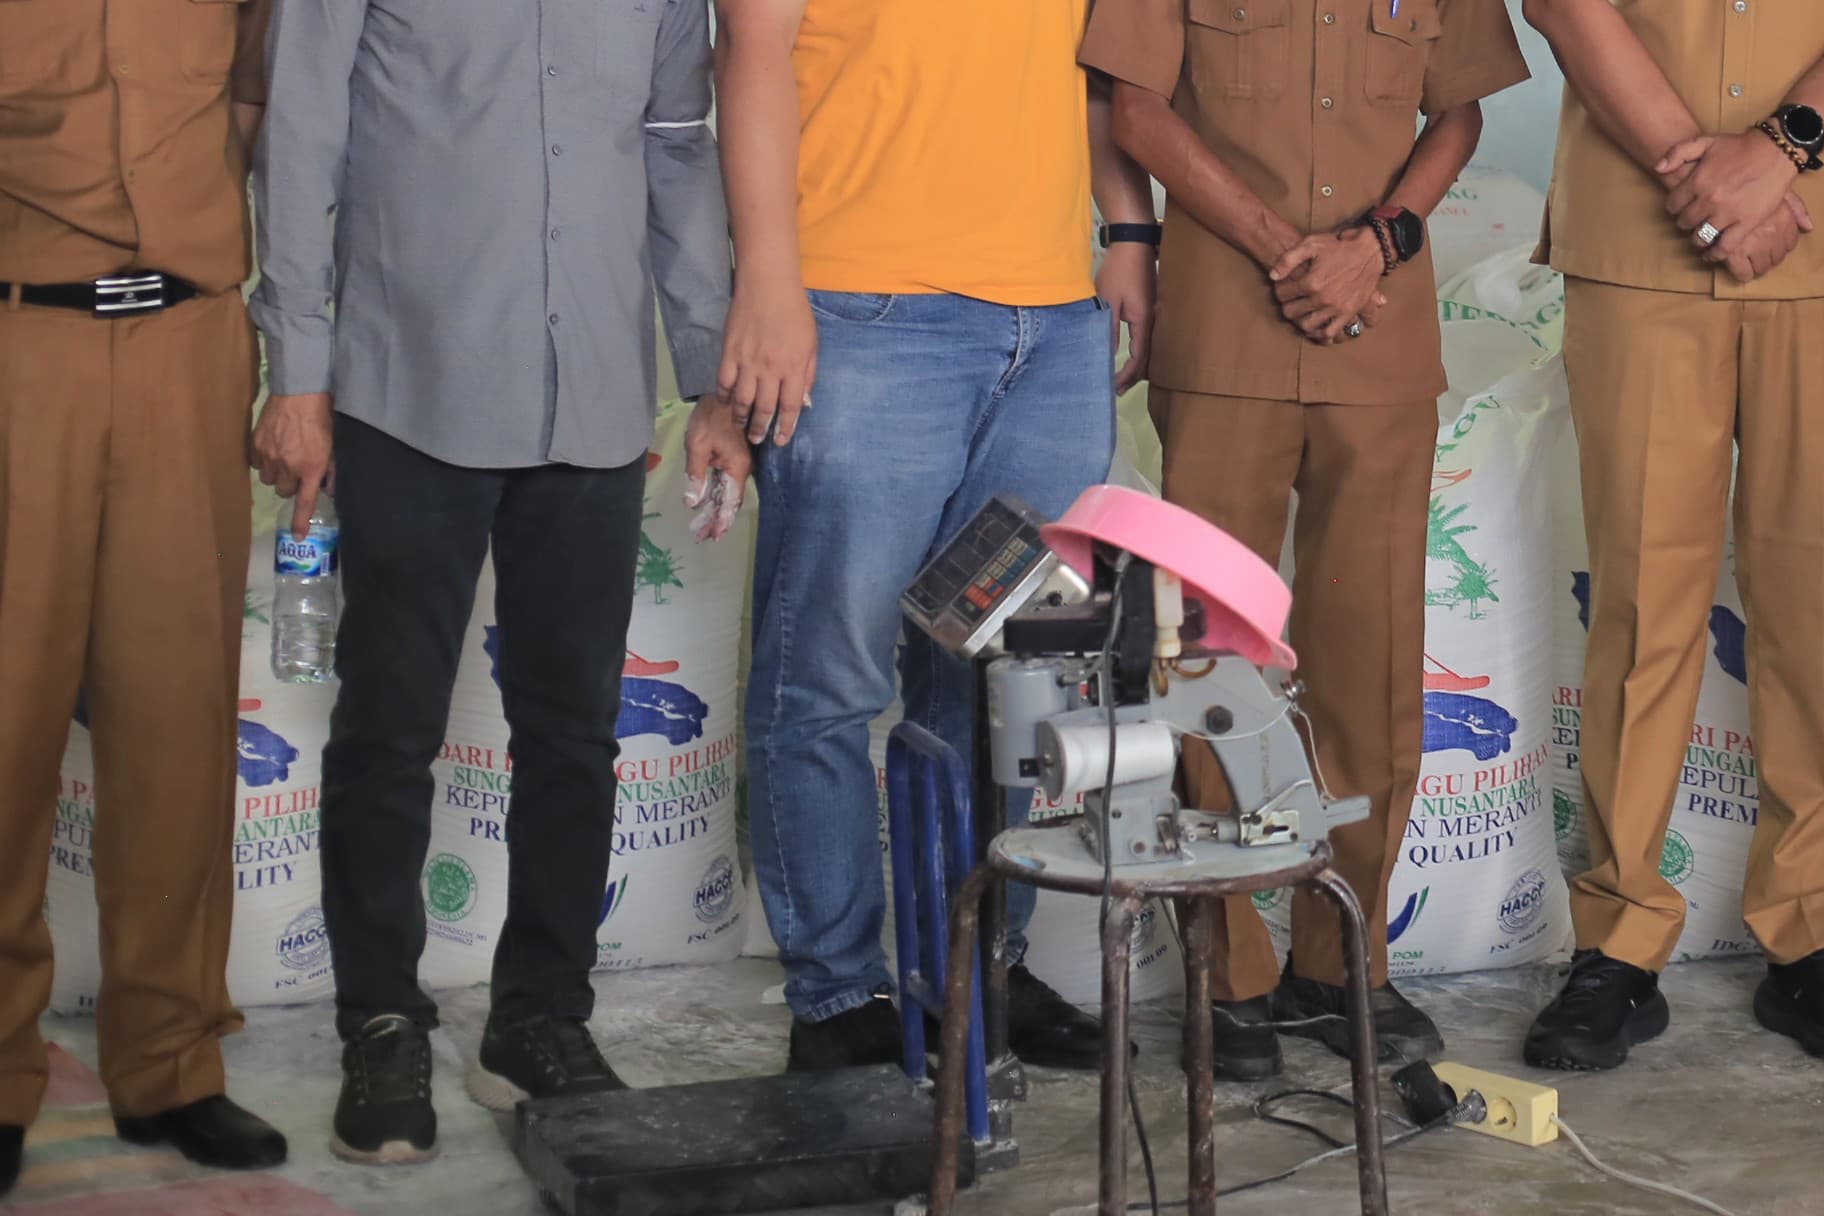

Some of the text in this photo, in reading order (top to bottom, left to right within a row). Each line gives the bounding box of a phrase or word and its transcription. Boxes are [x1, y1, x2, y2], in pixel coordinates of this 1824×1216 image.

[280, 542, 316, 560] AQUA
[1680, 765, 1760, 801] EPUL
[244, 786, 320, 820] PILIH
[611, 813, 709, 857] QUALITY
[1408, 827, 1519, 869] QUALITY
[1392, 950, 1424, 960] POM
